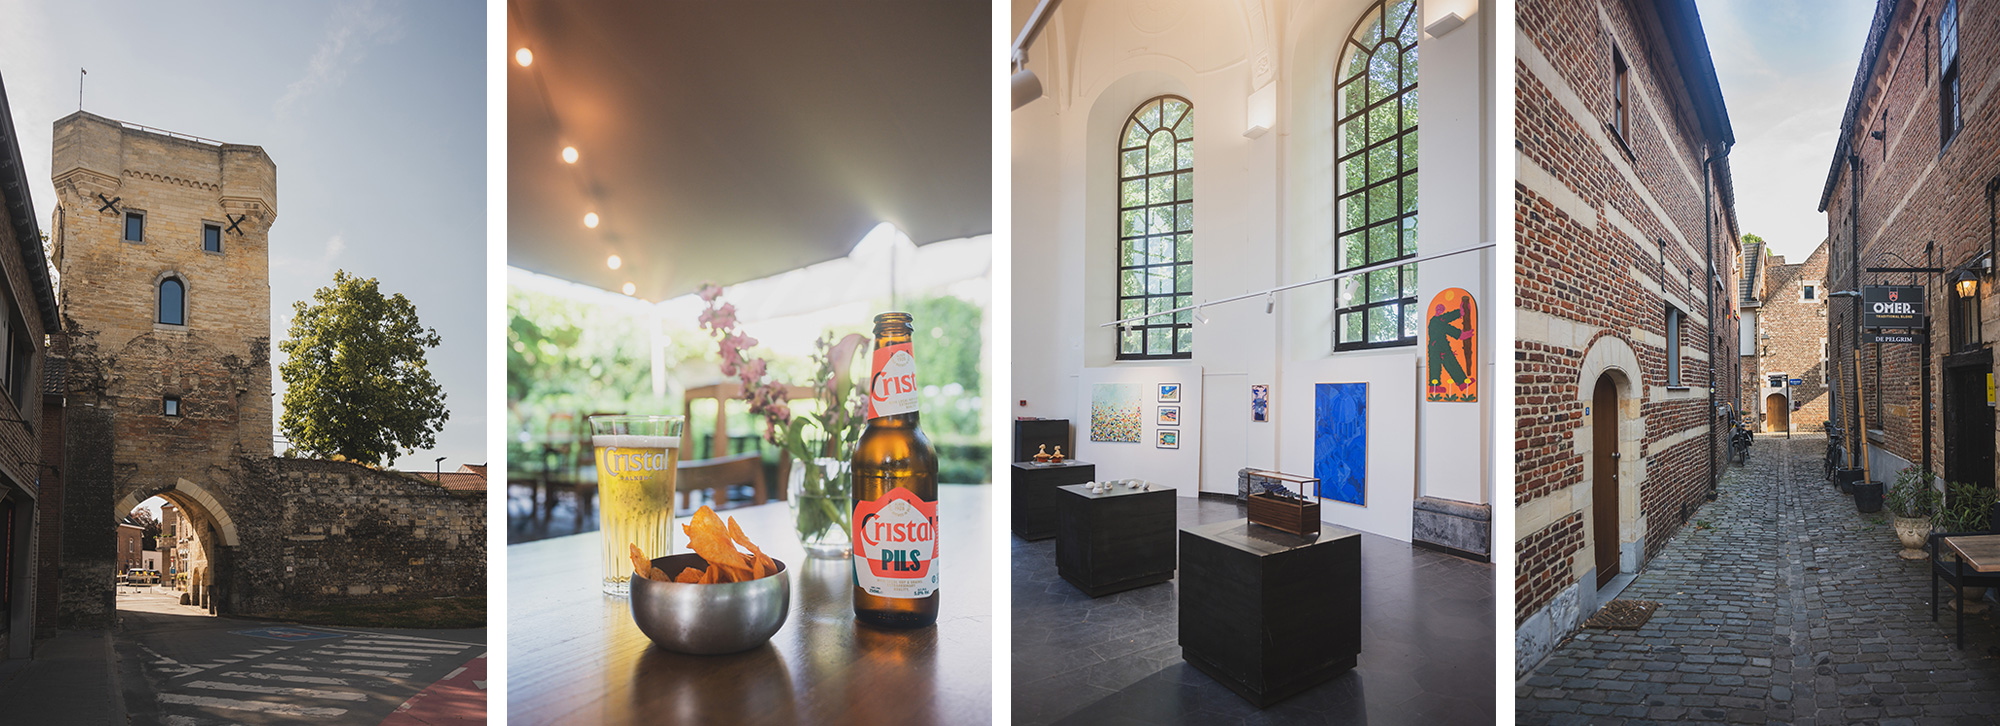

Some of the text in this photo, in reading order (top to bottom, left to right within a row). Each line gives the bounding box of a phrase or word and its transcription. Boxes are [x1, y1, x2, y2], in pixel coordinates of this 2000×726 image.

[1873, 302, 1916, 314] OMER.
[603, 446, 669, 477] Cristal
[861, 513, 933, 547] Cristal
[881, 549, 921, 572] PILS
